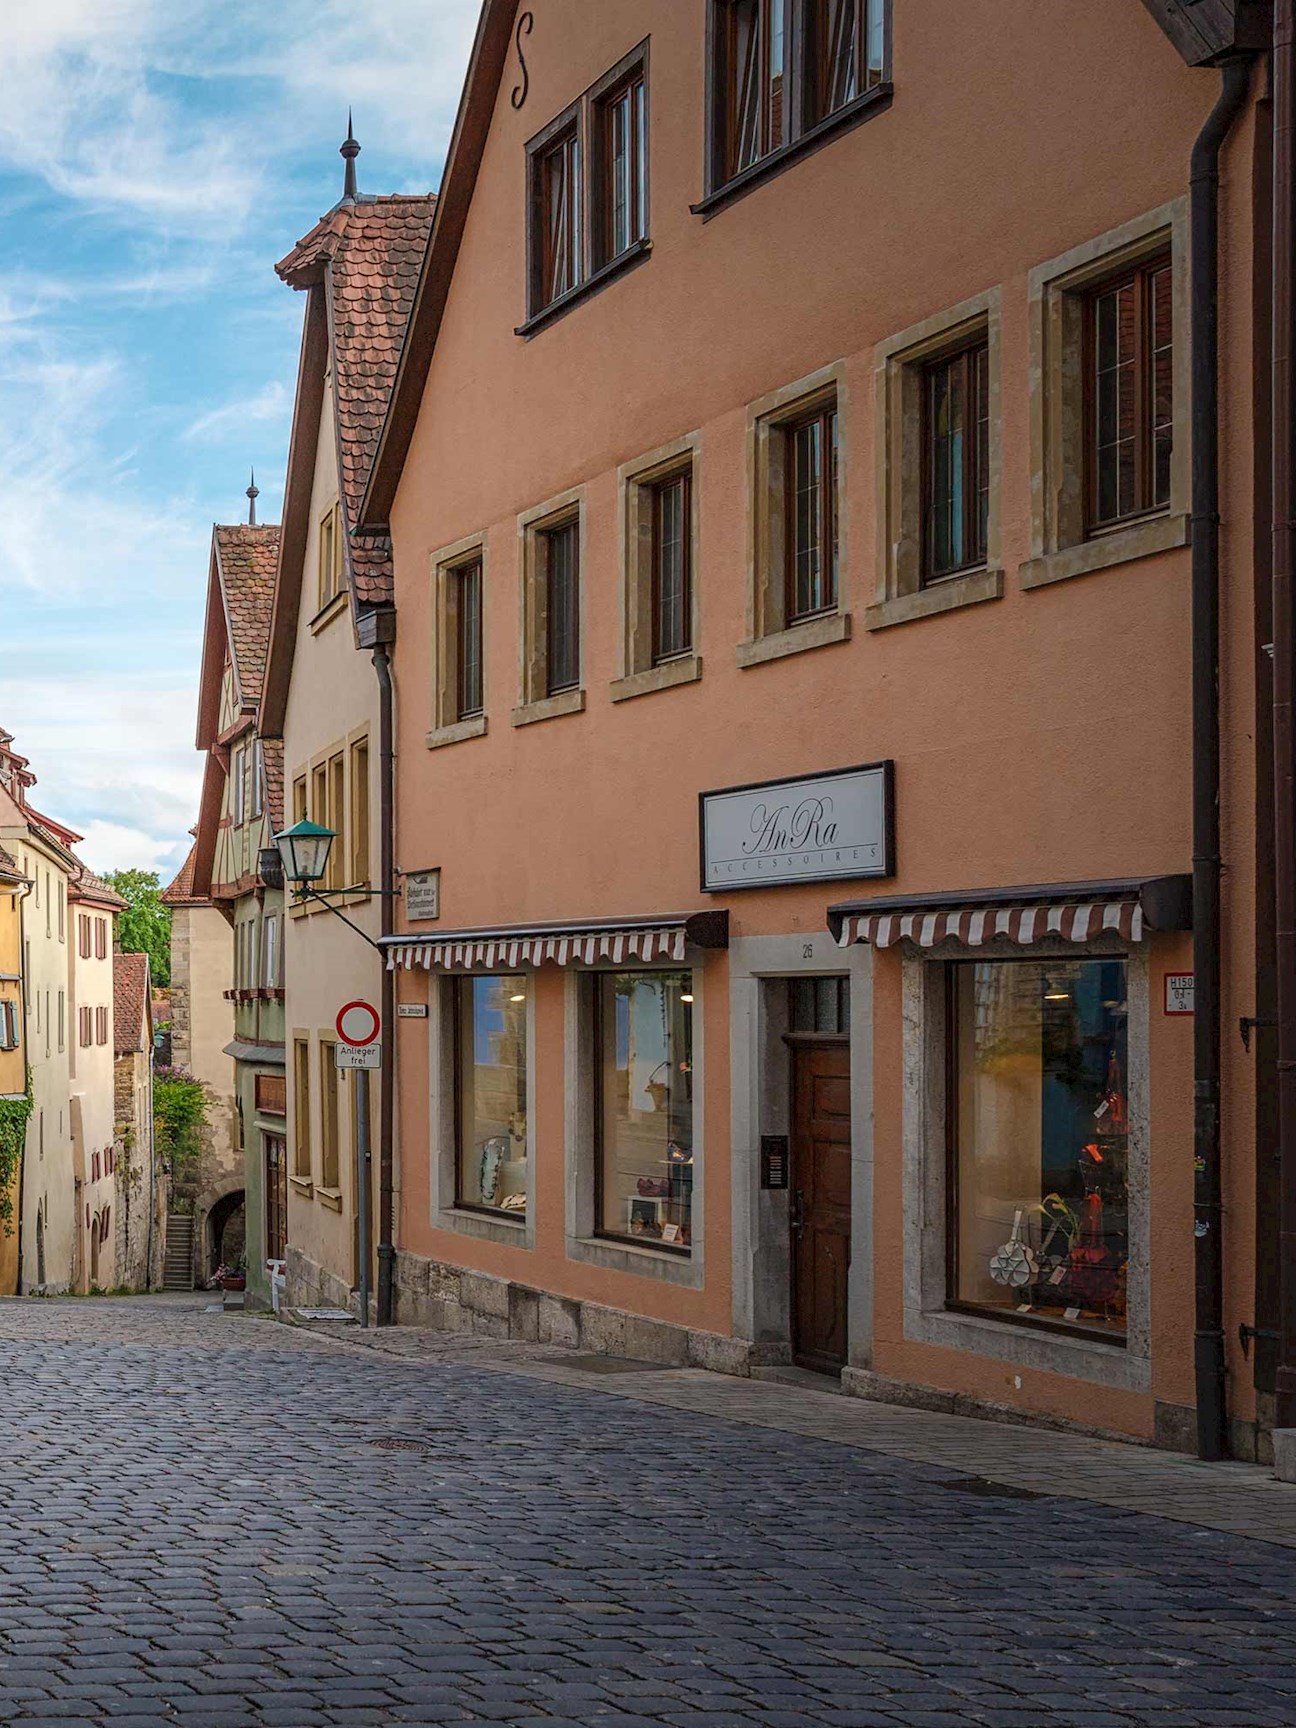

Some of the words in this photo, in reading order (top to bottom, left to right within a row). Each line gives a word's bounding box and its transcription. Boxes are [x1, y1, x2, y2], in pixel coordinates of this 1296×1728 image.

[742, 796, 840, 854] AnRa
[713, 847, 877, 874] ACCESSOIRES
[803, 944, 813, 959] 26
[1170, 977, 1193, 988] H150
[340, 1047, 376, 1057] Anlieger
[351, 1056, 366, 1065] frei
